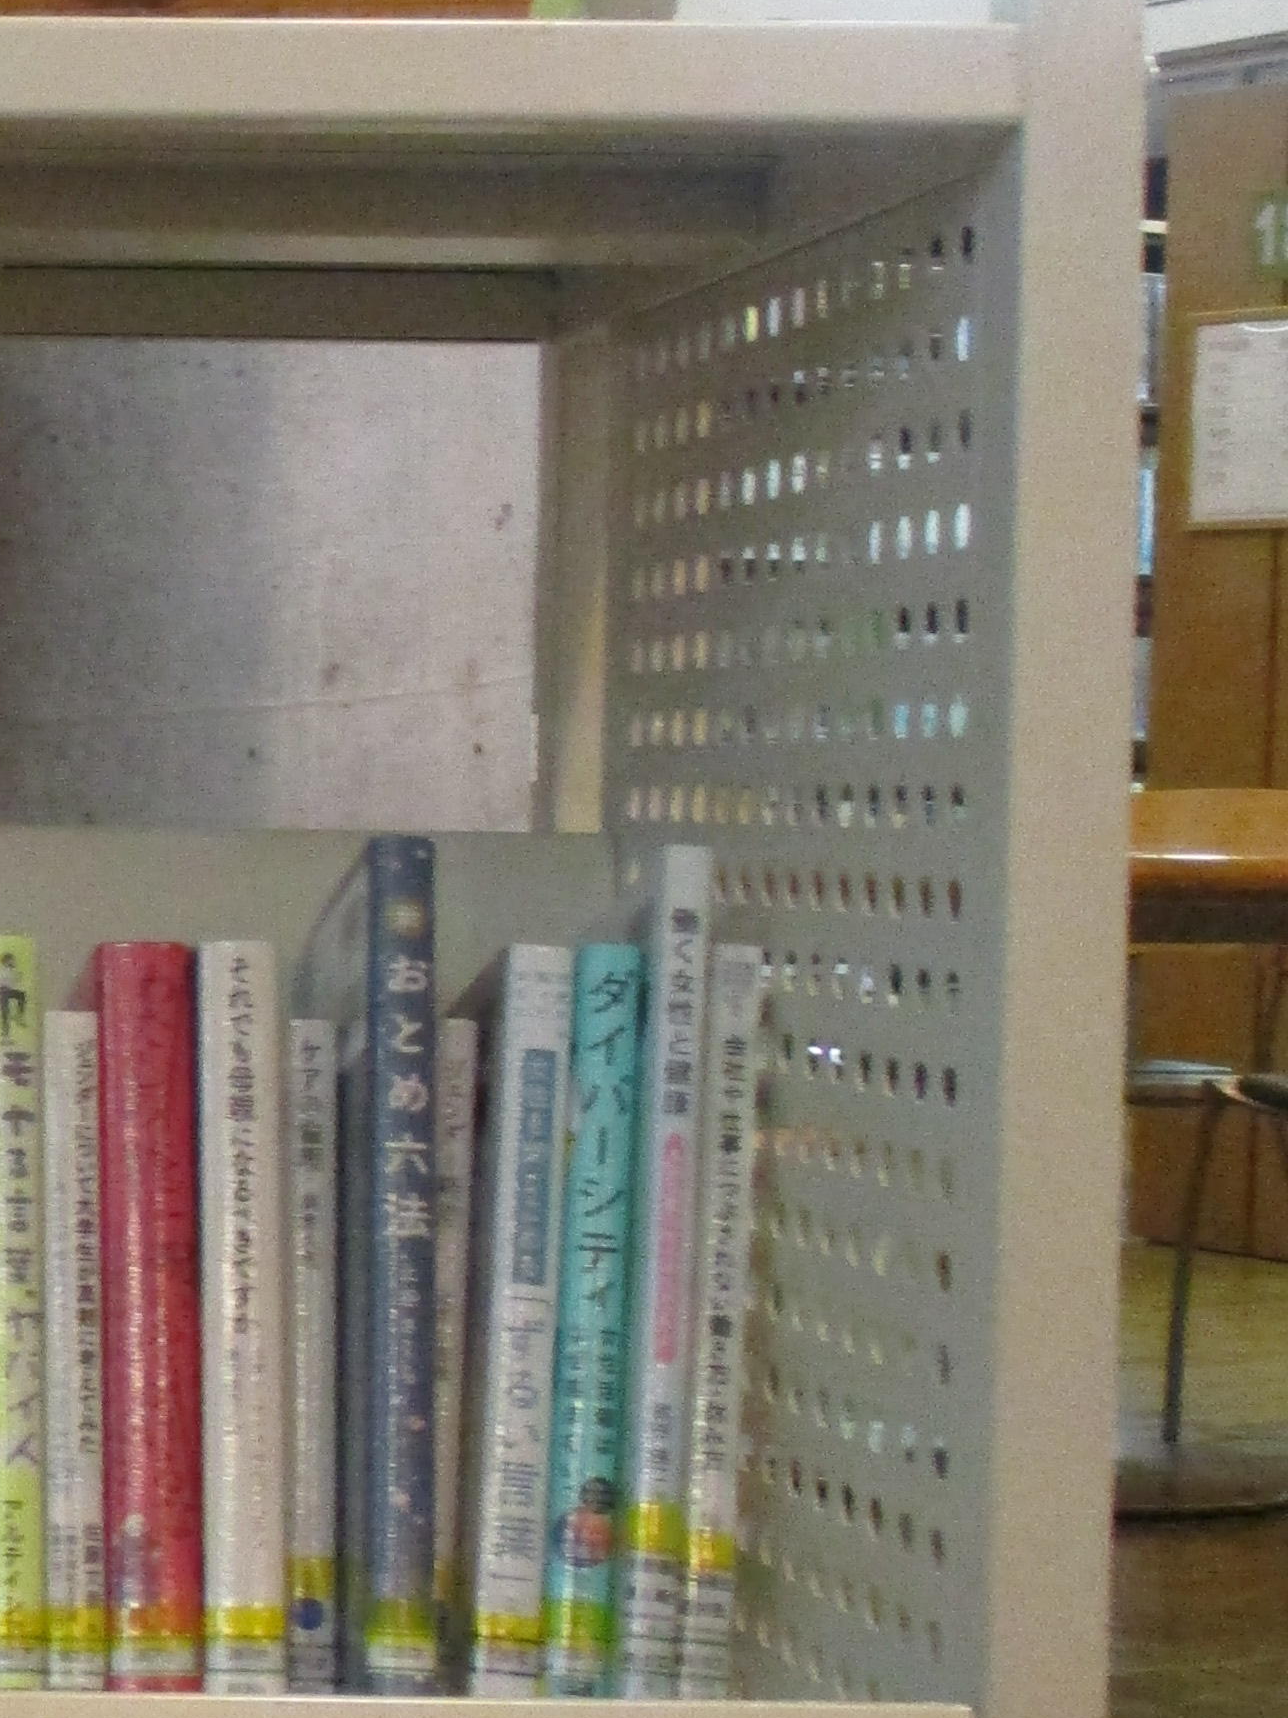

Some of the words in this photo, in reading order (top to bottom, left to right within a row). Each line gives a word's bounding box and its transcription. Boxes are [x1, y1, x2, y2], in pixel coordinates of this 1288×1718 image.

[381, 957, 430, 1241] おとめ六法
[576, 970, 631, 1308] ダイバーシティ
